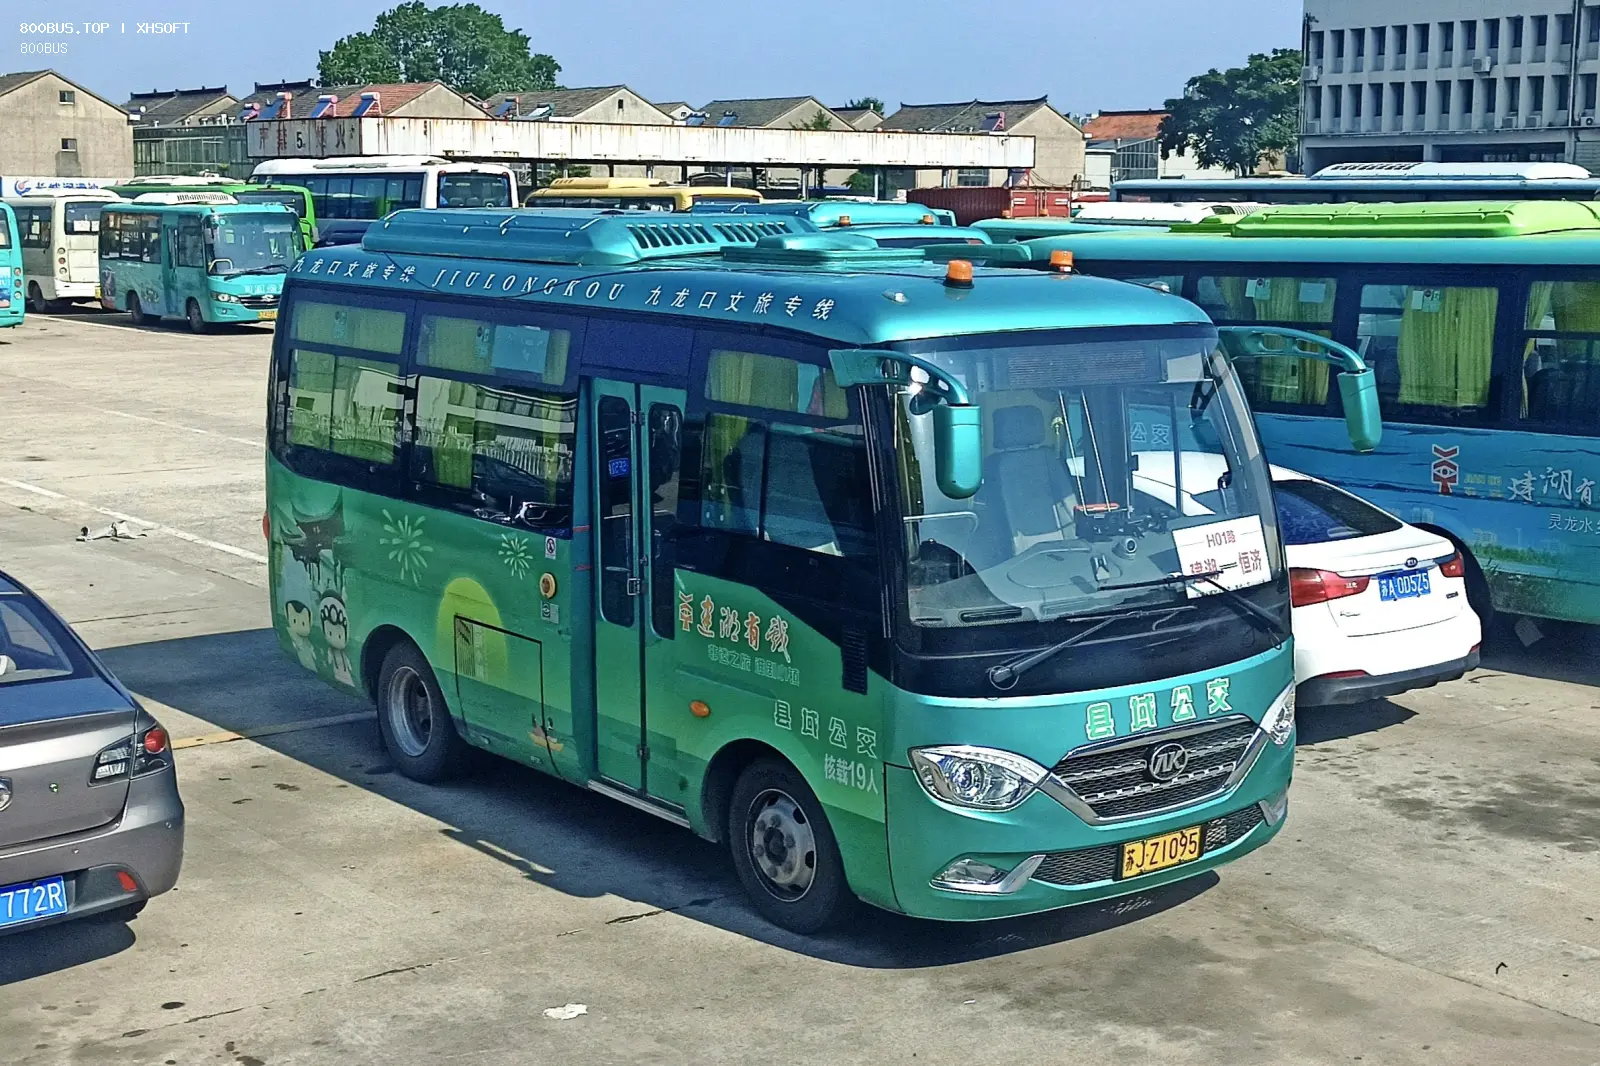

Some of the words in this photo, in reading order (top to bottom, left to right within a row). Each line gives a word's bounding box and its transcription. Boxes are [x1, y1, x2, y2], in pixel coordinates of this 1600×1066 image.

[292, 255, 417, 284] 九龙口文旅专线
[431, 269, 625, 301] JIULONGKOU
[644, 284, 836, 321] 九龙口文旅专线
[1131, 422, 1169, 445] 公交
[1507, 466, 1600, 505] 建湖有
[1085, 677, 1232, 741] 县域公交
